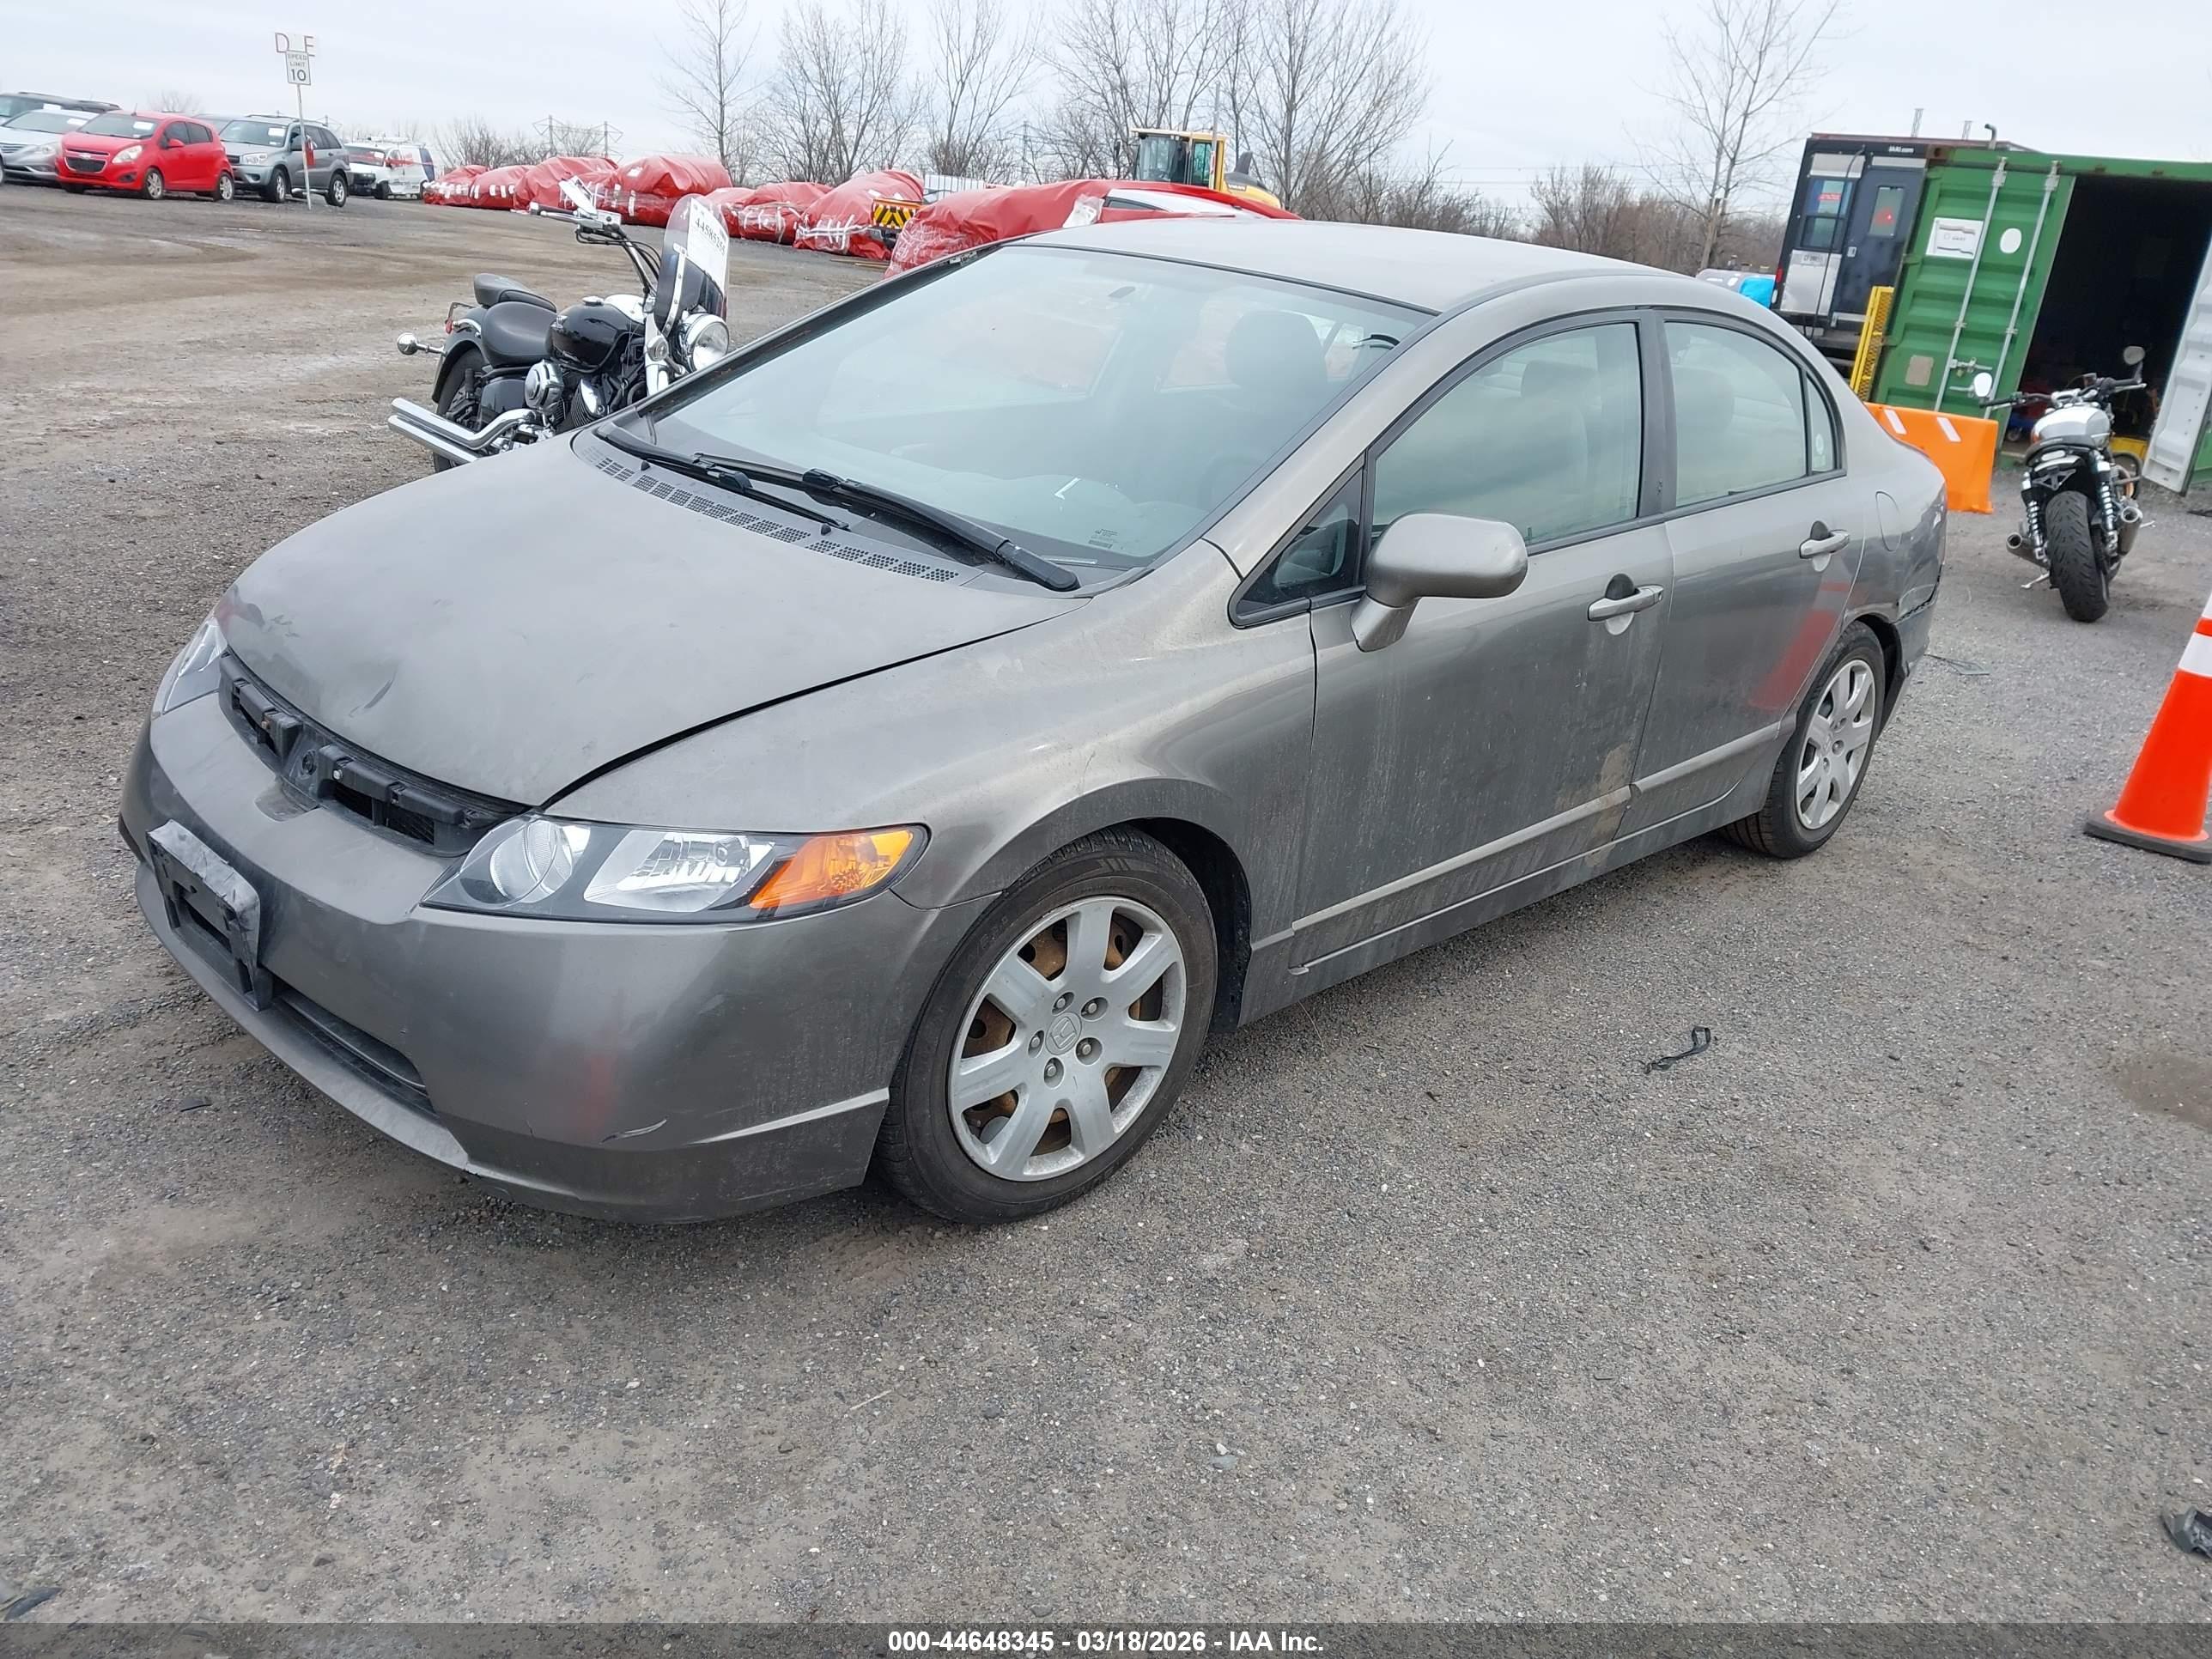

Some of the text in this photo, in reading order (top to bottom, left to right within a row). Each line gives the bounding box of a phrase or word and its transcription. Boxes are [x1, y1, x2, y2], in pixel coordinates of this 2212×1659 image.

[275, 32, 315, 57] D E
[291, 69, 307, 82] 10
